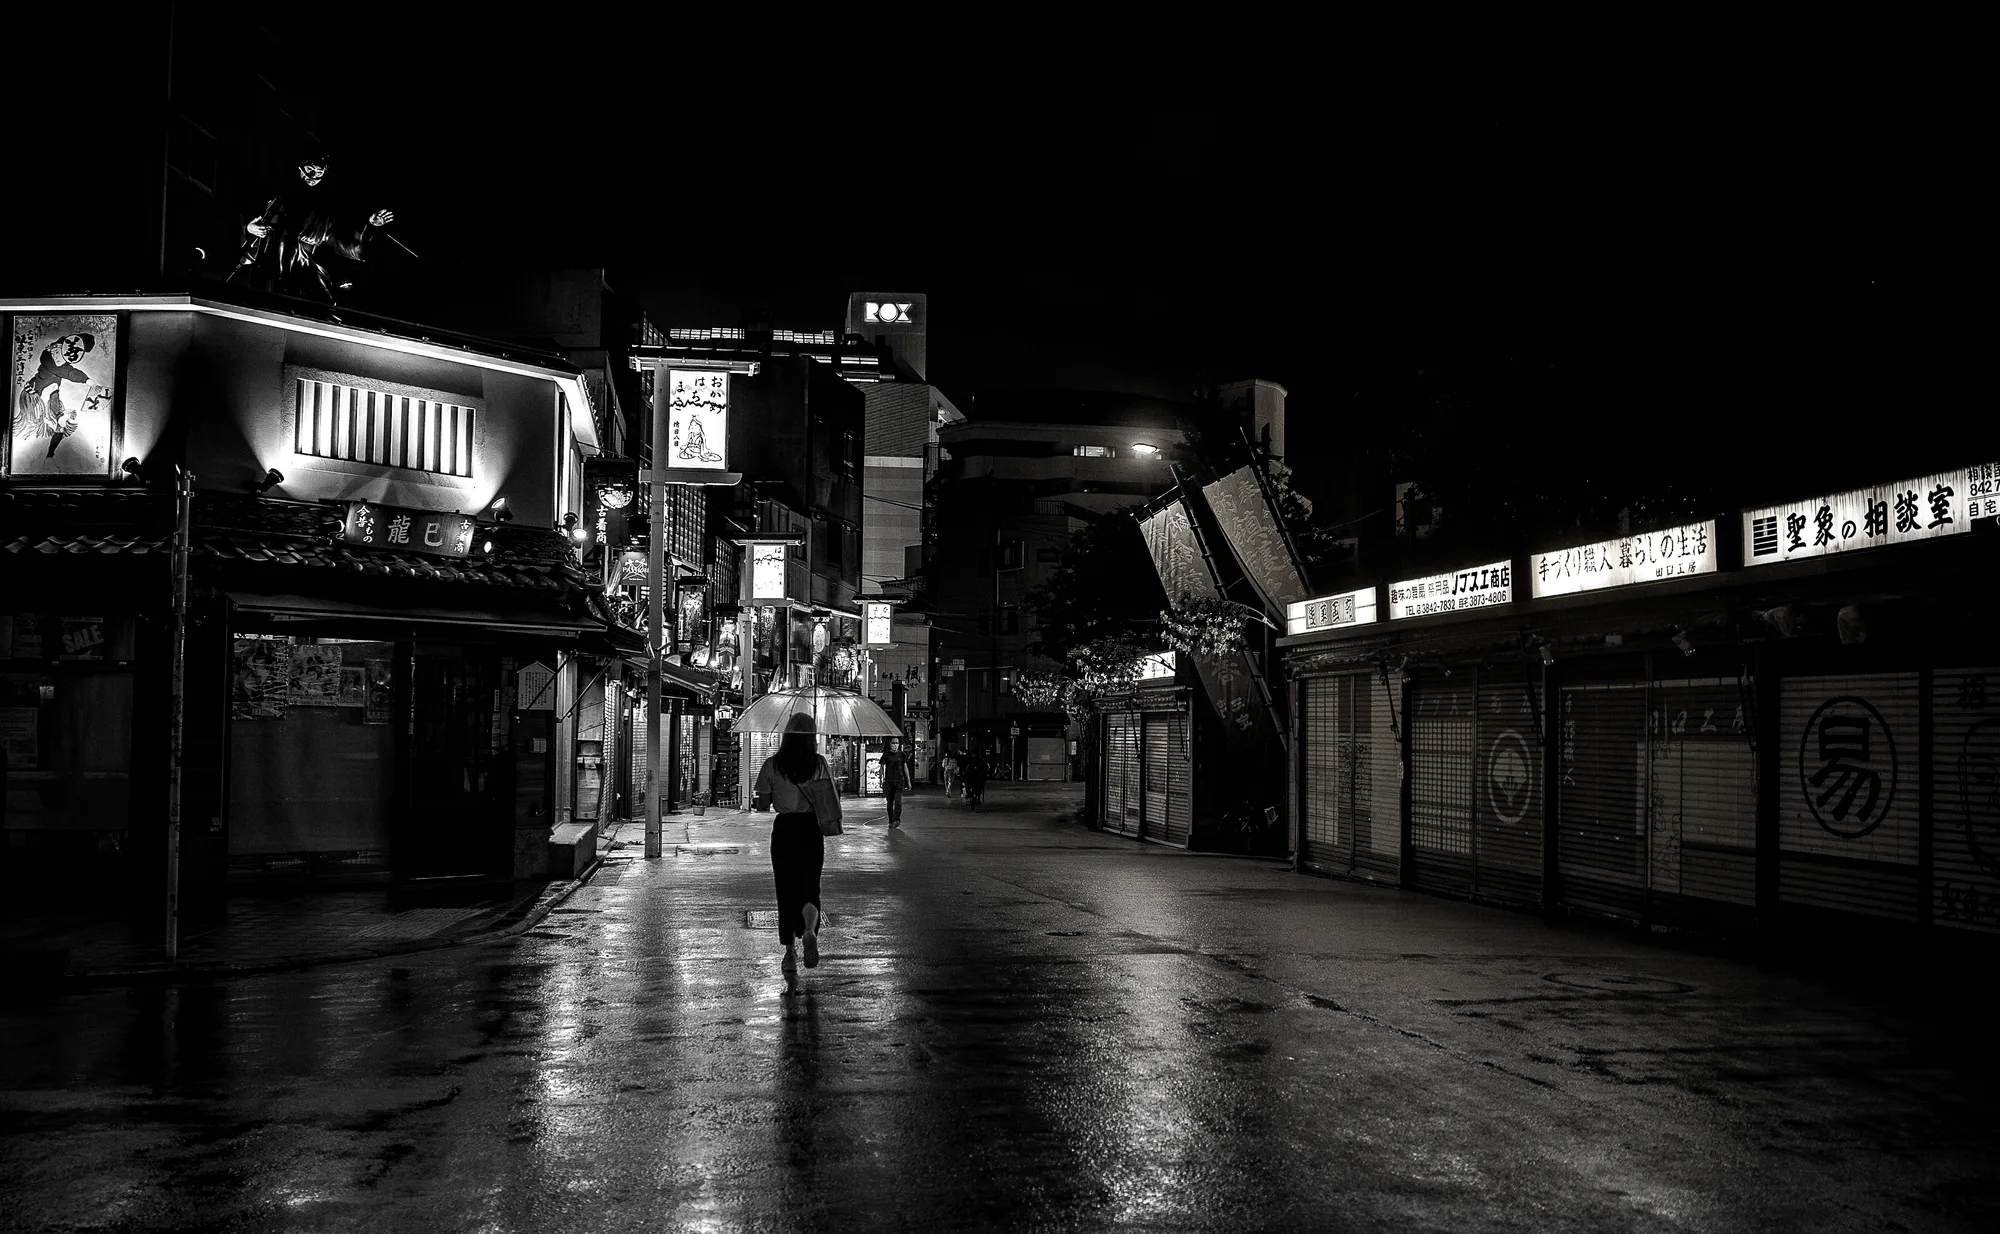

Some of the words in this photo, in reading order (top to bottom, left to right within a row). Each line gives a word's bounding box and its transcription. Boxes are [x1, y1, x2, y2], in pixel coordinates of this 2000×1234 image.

[864, 302, 912, 323] ROX
[355, 505, 371, 528] 今昔
[1785, 483, 1955, 553] 聖象の相談室
[1969, 499, 1997, 517] 自宅
[362, 517, 375, 543] きもの
[453, 519, 472, 553] 古着商
[596, 505, 609, 544] 古着商
[1538, 546, 1613, 582] 手づくり職人
[1619, 525, 1707, 569] 暮らしの生活
[61, 624, 105, 654] SALE
[1809, 717, 1882, 822] 易
